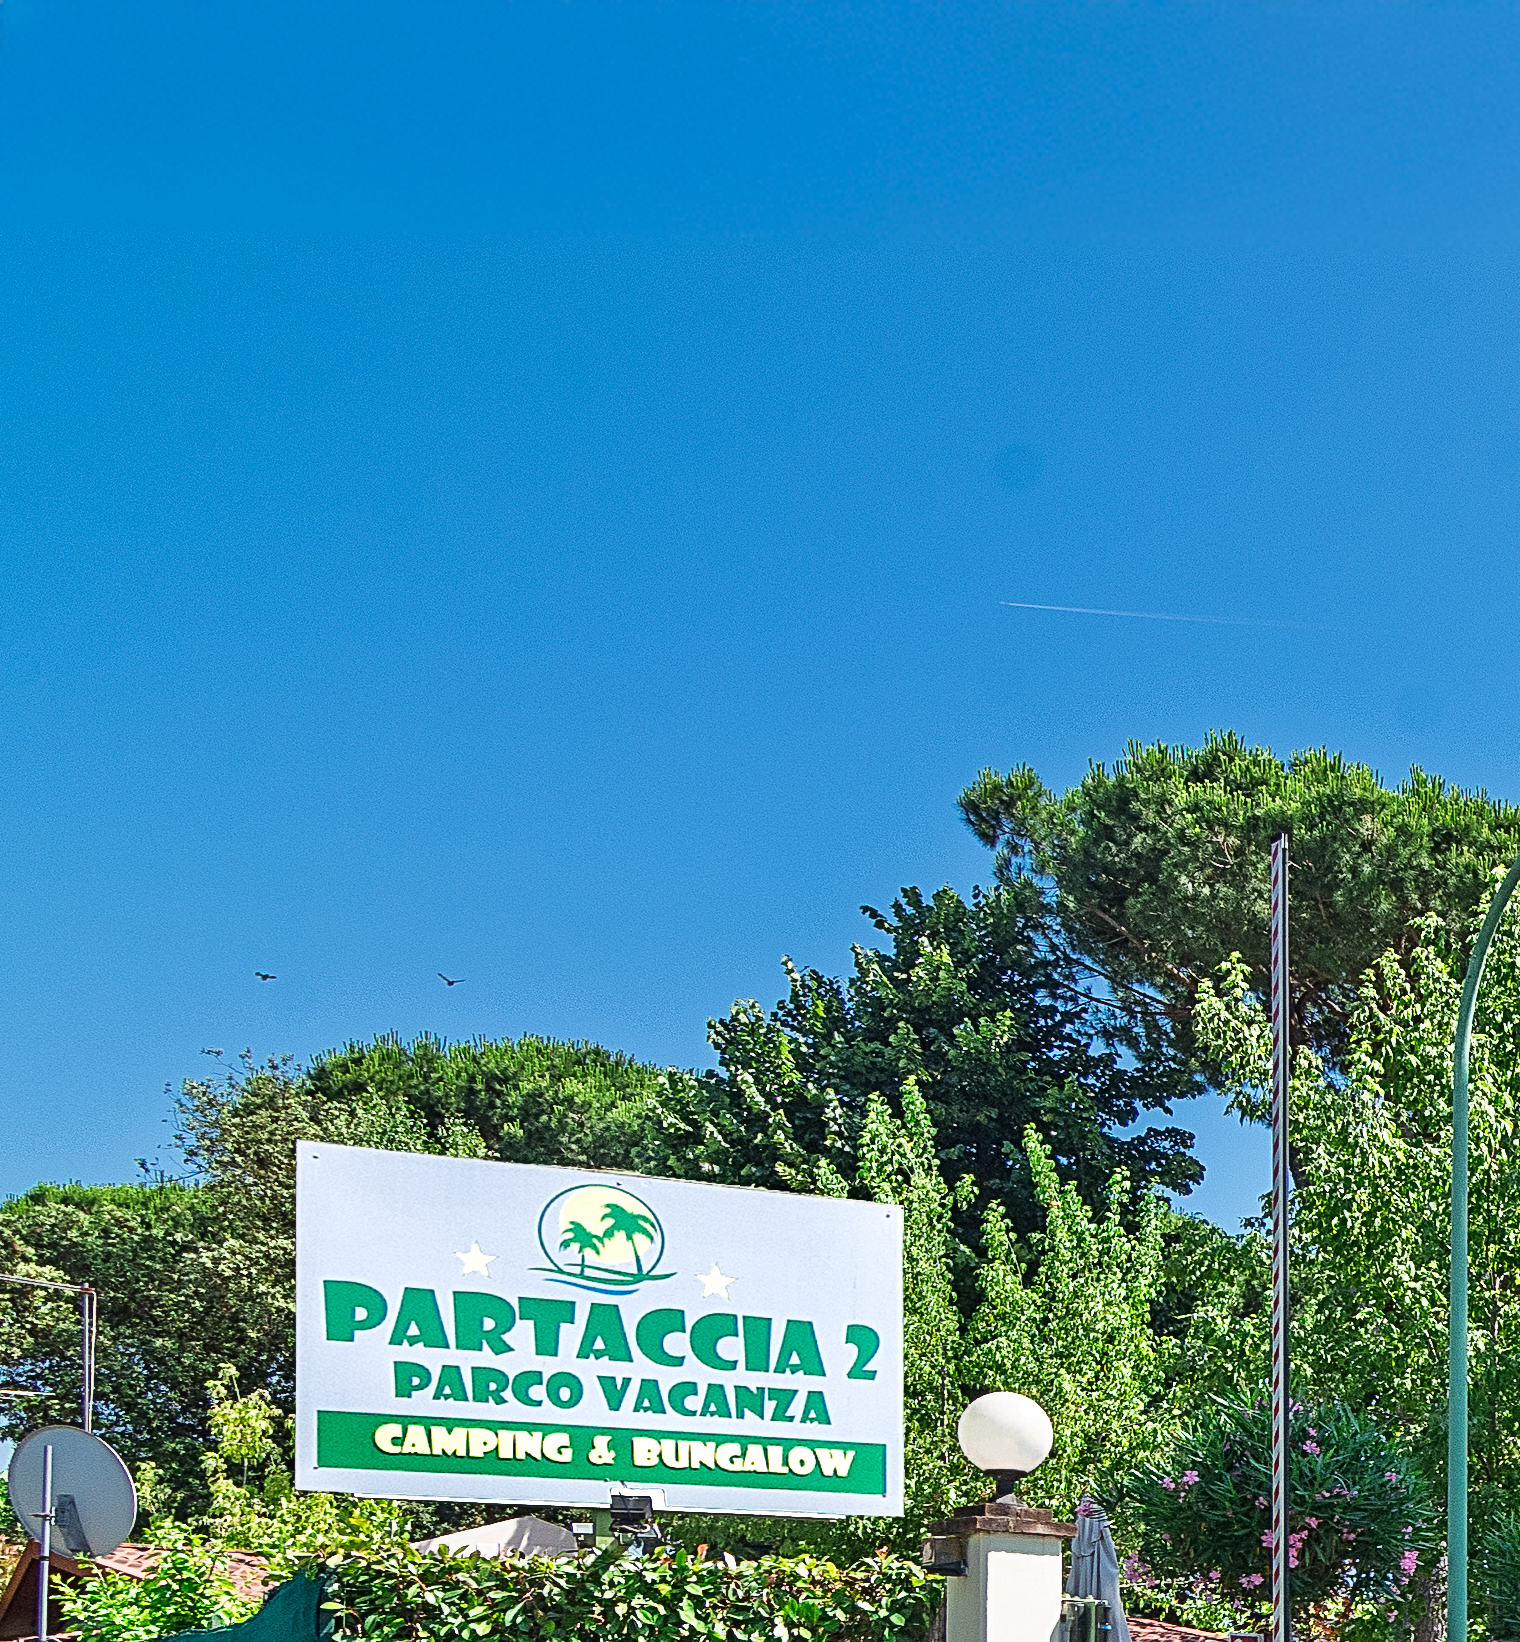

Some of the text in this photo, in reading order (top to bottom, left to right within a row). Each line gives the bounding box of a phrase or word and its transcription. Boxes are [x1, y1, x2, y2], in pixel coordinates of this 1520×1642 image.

[323, 1279, 880, 1381] PARTACCIA 2
[394, 1361, 832, 1426] PARCO VACANZA
[374, 1423, 856, 1478] CAMPING & BUNGALOW
